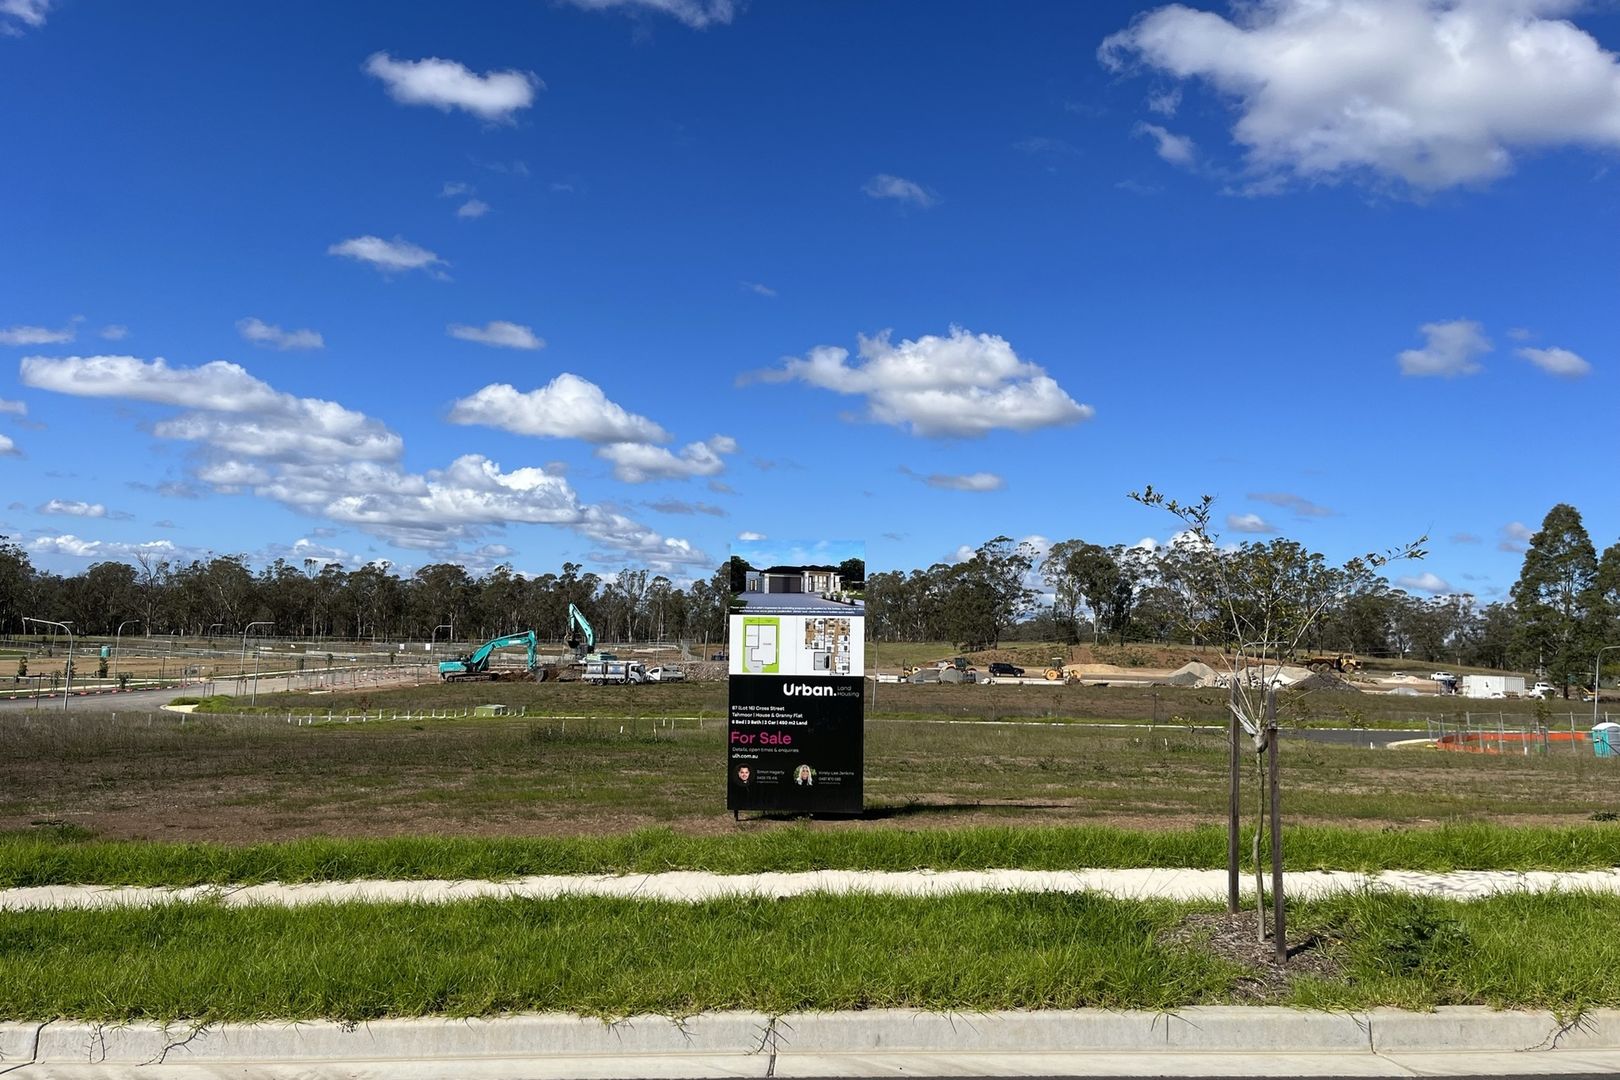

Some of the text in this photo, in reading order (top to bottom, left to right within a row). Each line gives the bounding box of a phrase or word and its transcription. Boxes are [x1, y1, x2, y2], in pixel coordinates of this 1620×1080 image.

[783, 683, 837, 696] Urban.
[731, 730, 792, 744] For Sale
